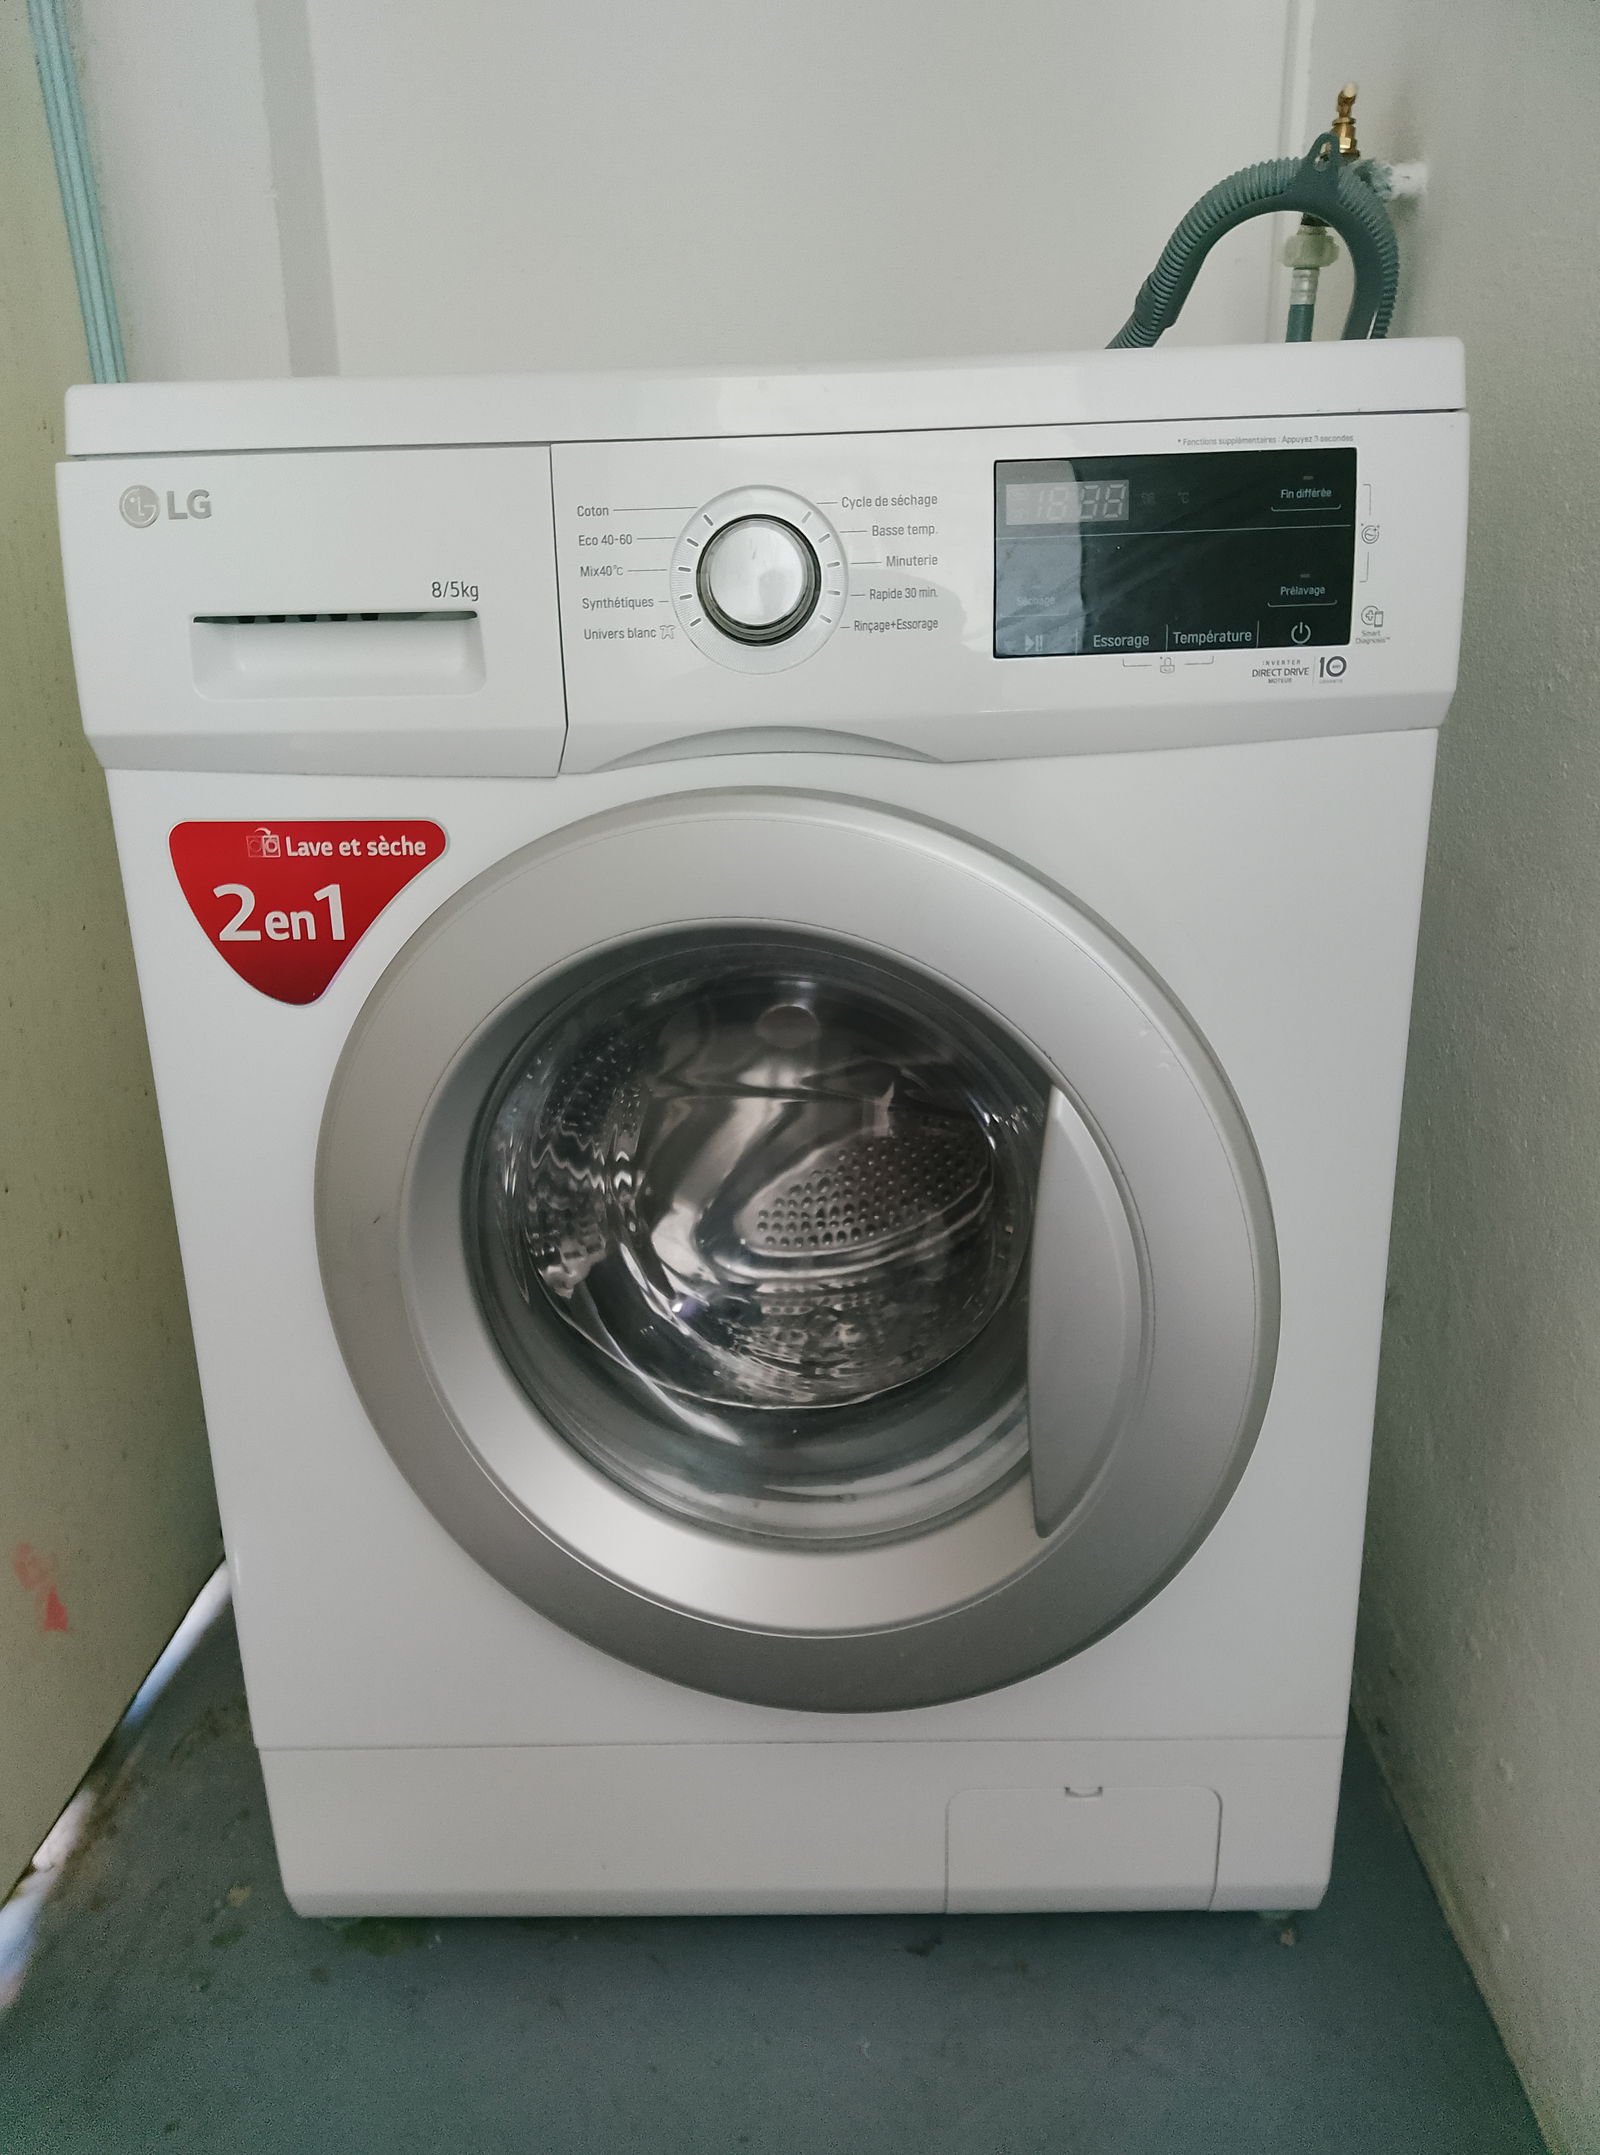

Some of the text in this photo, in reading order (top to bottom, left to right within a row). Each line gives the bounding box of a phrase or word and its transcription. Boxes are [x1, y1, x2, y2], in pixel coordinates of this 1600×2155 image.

[1281, 487, 1332, 499] Fin différée
[167, 489, 212, 520] LG
[842, 494, 938, 510] Cycle de séchage
[577, 505, 609, 517] Coton
[872, 524, 938, 538] Basse temp.
[579, 534, 632, 546] Eco 40-60
[886, 555, 938, 567] Minuterie
[431, 581, 479, 602] 8/5kg
[870, 586, 938, 602] Rapide 30 min.
[1280, 585, 1326, 597] Prélavage
[582, 597, 654, 611] Synthétiques
[854, 618, 939, 633] Rinçage+Essorage
[584, 627, 656, 640] Univers blanc
[1173, 630, 1252, 646] Température
[1093, 634, 1150, 649] Essorage
[1252, 667, 1309, 678] DIRECT DRIVE
[286, 835, 426, 857] Lave et sèche
